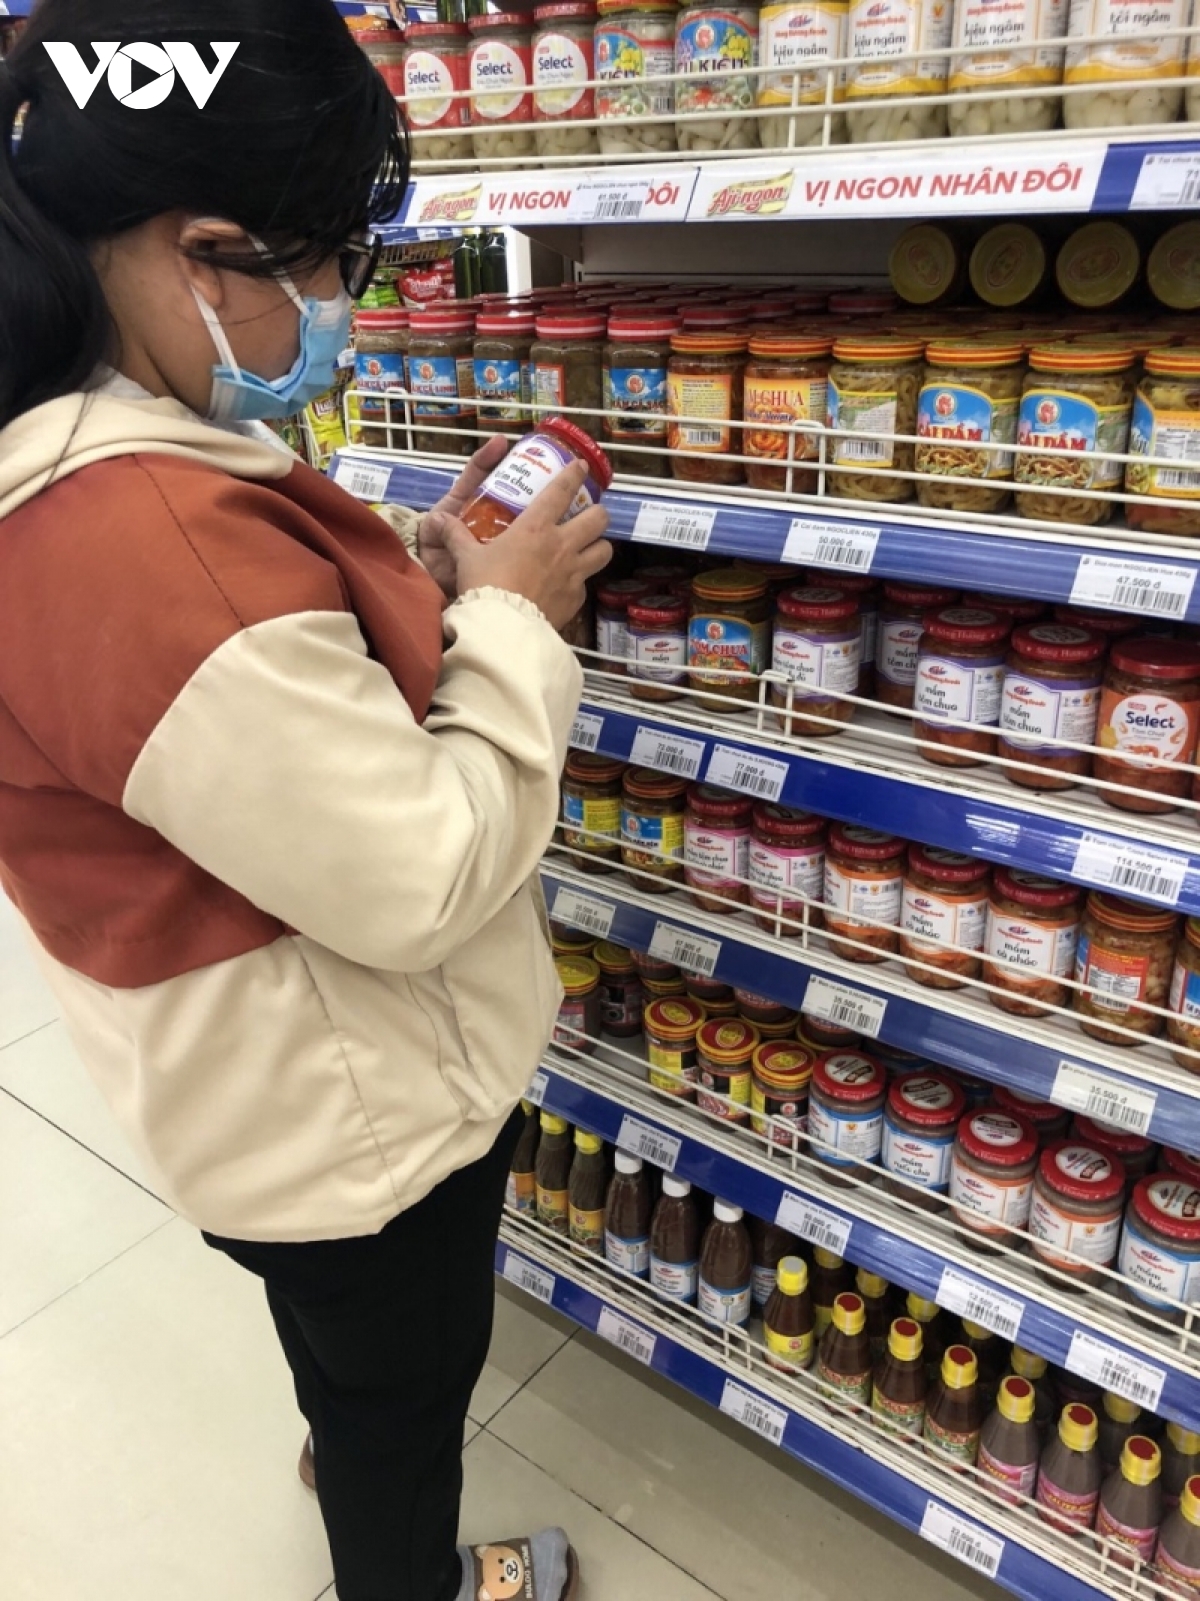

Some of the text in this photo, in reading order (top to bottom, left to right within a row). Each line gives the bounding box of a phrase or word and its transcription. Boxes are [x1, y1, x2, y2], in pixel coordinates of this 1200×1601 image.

[476, 60, 514, 76] Select
[537, 54, 575, 71] Select
[407, 69, 441, 85] Select
[804, 180, 830, 207] VỊ
[835, 175, 924, 200] NGON
[929, 166, 1021, 197] NHÂN
[1022, 162, 1084, 193] ĐÔI
[488, 192, 507, 216] VỊ
[509, 189, 573, 210] NGON
[510, 476, 534, 496] chua
[925, 684, 946, 697] mắm
[933, 698, 958, 711] chua
[1009, 705, 1030, 719] mắm
[1017, 718, 1042, 734] chua
[1125, 710, 1176, 729] Select
[1004, 941, 1031, 955] mắm
